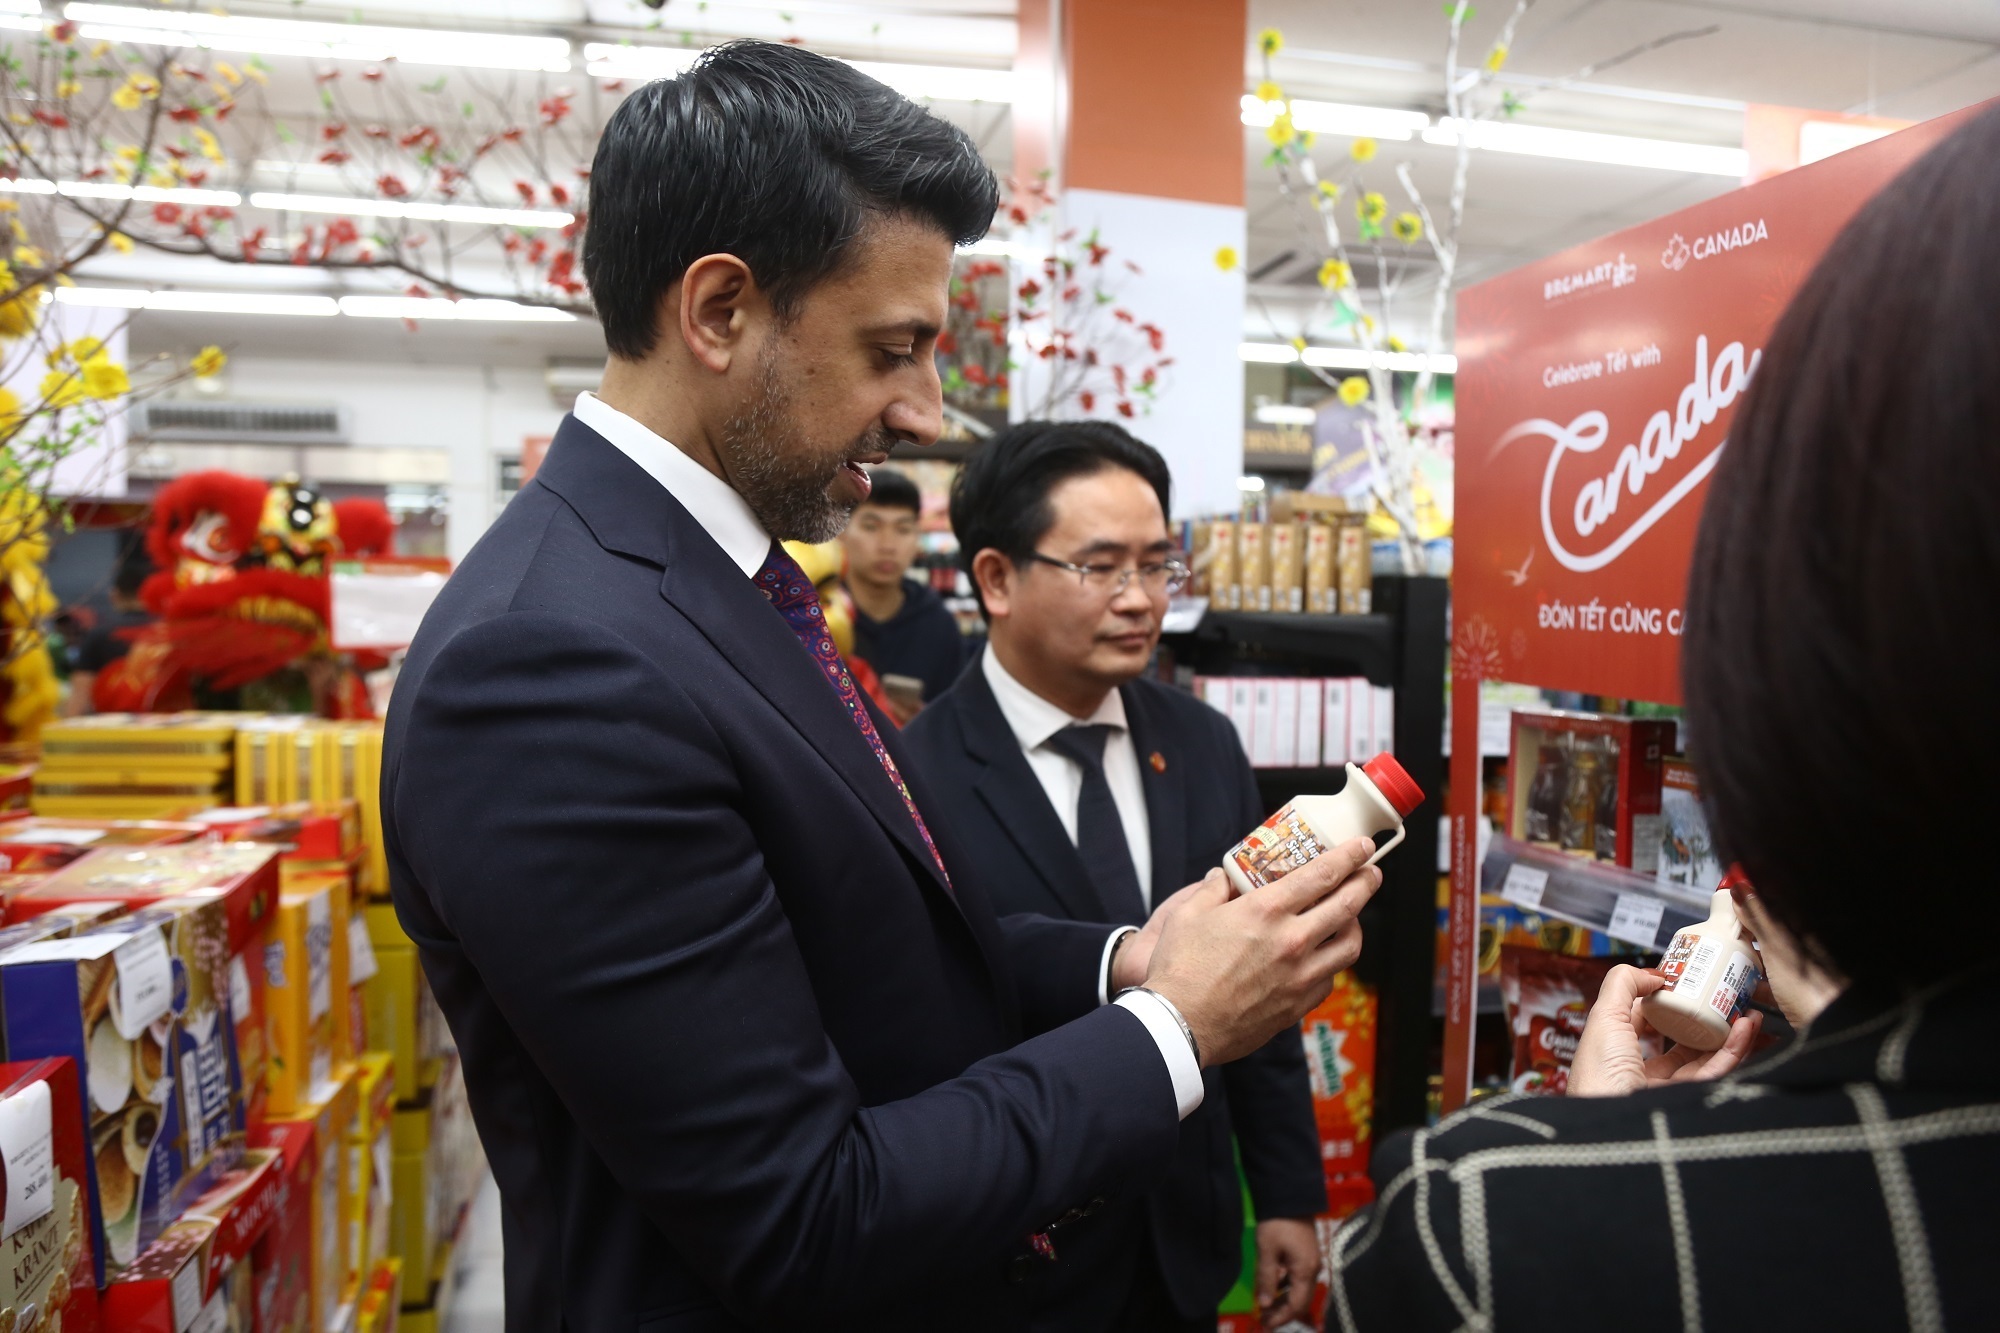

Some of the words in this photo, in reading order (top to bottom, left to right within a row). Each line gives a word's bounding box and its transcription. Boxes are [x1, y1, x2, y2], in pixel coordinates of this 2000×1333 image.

[1693, 218, 1768, 260] CANADA
[1543, 360, 1602, 388] Celebrate
[1631, 343, 1661, 368] with
[1490, 335, 1762, 572] Canada
[1538, 599, 1575, 630] ĐÓN
[1578, 596, 1608, 632] TẾT
[1609, 601, 1663, 635] CÙNG
[1288, 821, 1306, 842] Pure
[1287, 840, 1308, 865] Sirop
